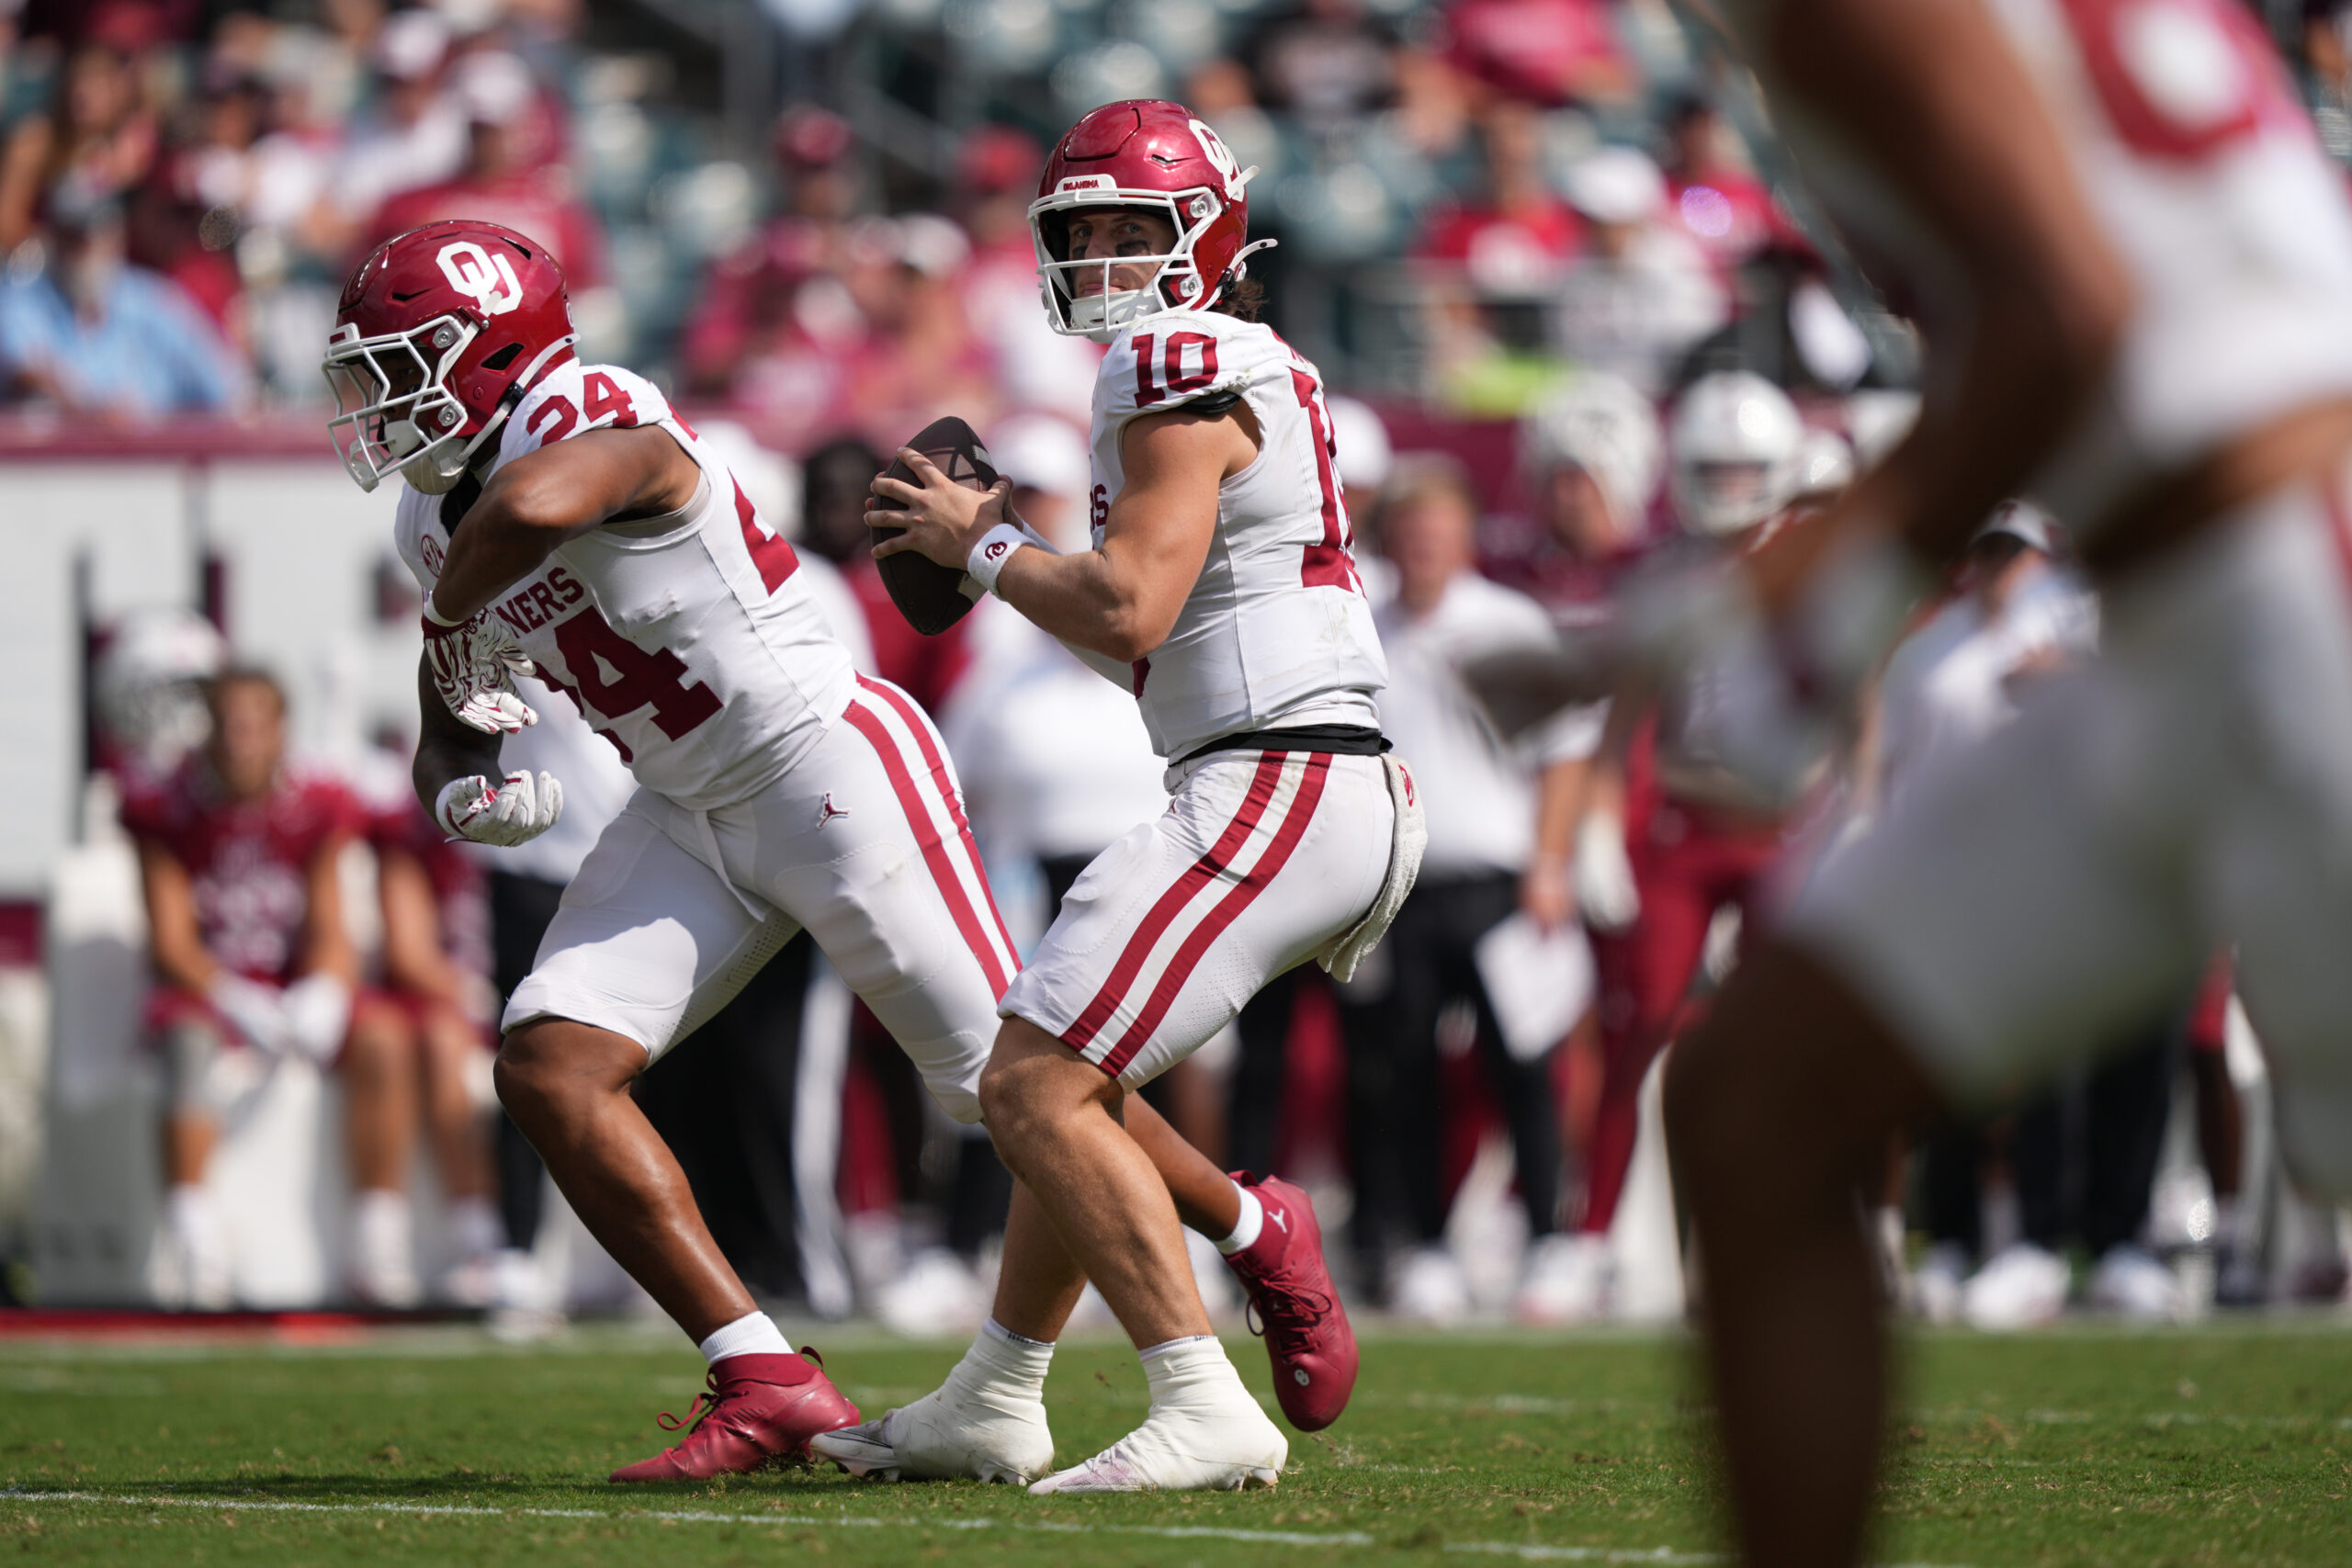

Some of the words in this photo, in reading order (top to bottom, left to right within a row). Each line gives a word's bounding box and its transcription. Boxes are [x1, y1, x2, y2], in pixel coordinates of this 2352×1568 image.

[1189, 118, 1245, 202] OU
[435, 241, 524, 315] OU
[1131, 331, 1219, 409] 10
[526, 371, 639, 447] 24
